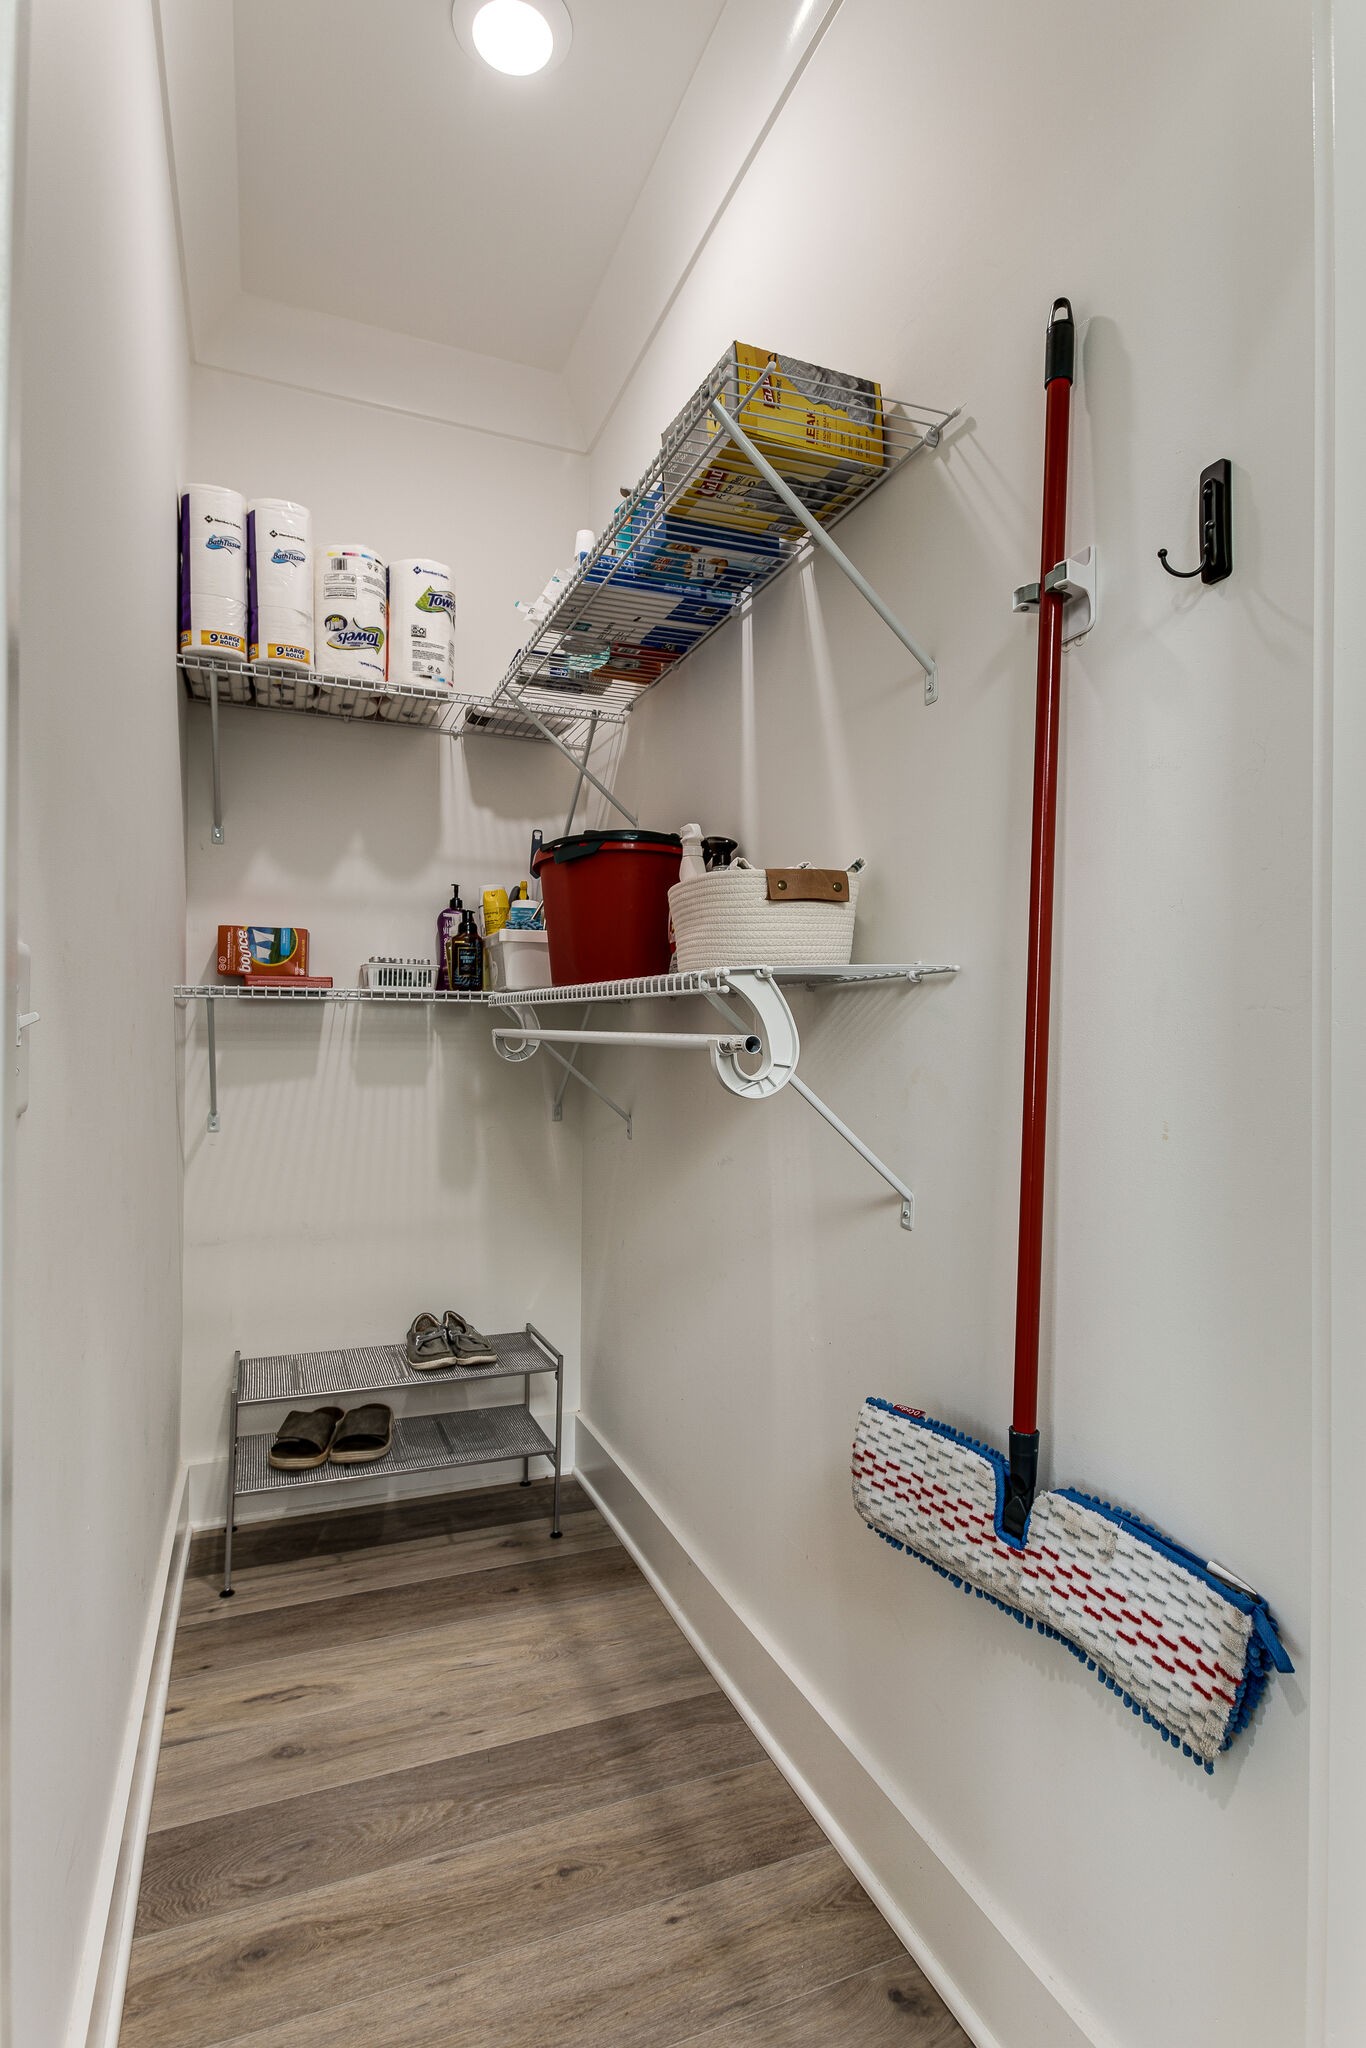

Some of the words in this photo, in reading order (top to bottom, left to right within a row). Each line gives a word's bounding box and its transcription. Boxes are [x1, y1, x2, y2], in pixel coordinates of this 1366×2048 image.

[210, 633, 218, 643] 9
[220, 634, 240, 643] LARGE
[336, 631, 380, 648] Towels
[276, 646, 285, 656] 9
[285, 647, 305, 656] LARGE
[238, 929, 252, 973] bounce
